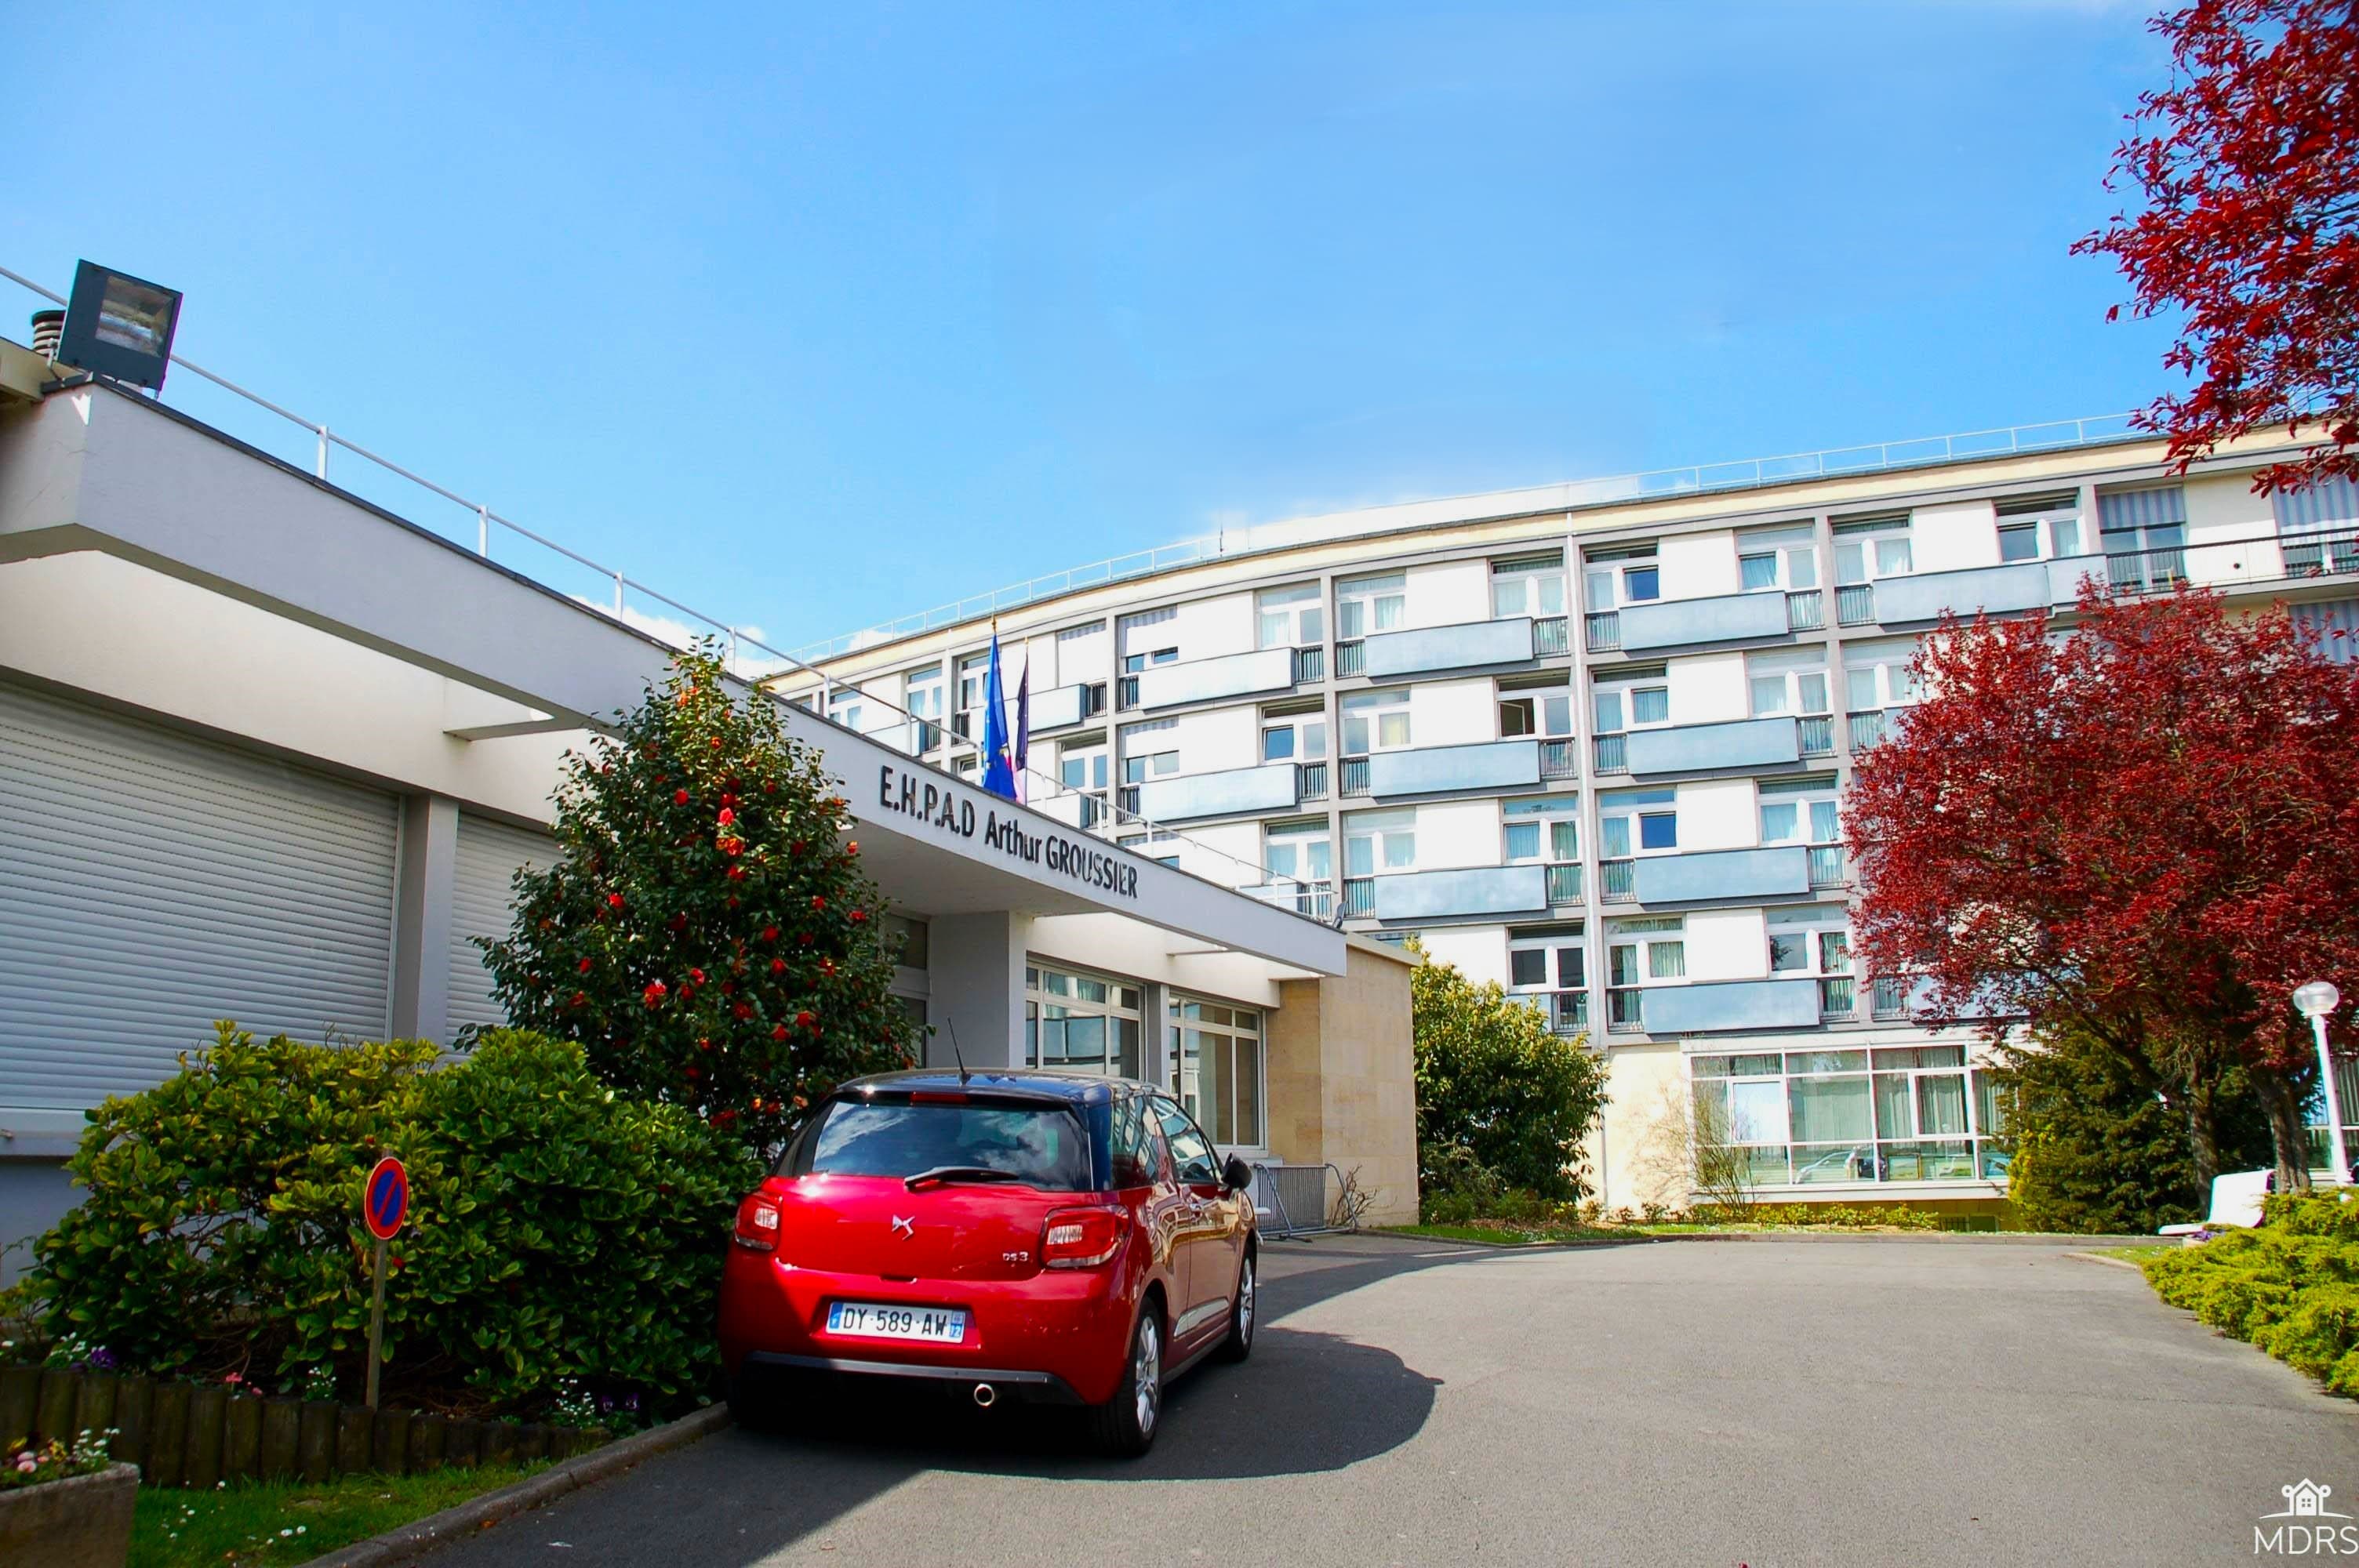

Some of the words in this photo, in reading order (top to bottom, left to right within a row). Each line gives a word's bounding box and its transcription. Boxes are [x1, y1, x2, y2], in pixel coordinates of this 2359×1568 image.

[881, 765, 975, 837] E.H.P.A.D
[985, 811, 1041, 863] Arthur
[1045, 836, 1138, 898] GROUSSIER
